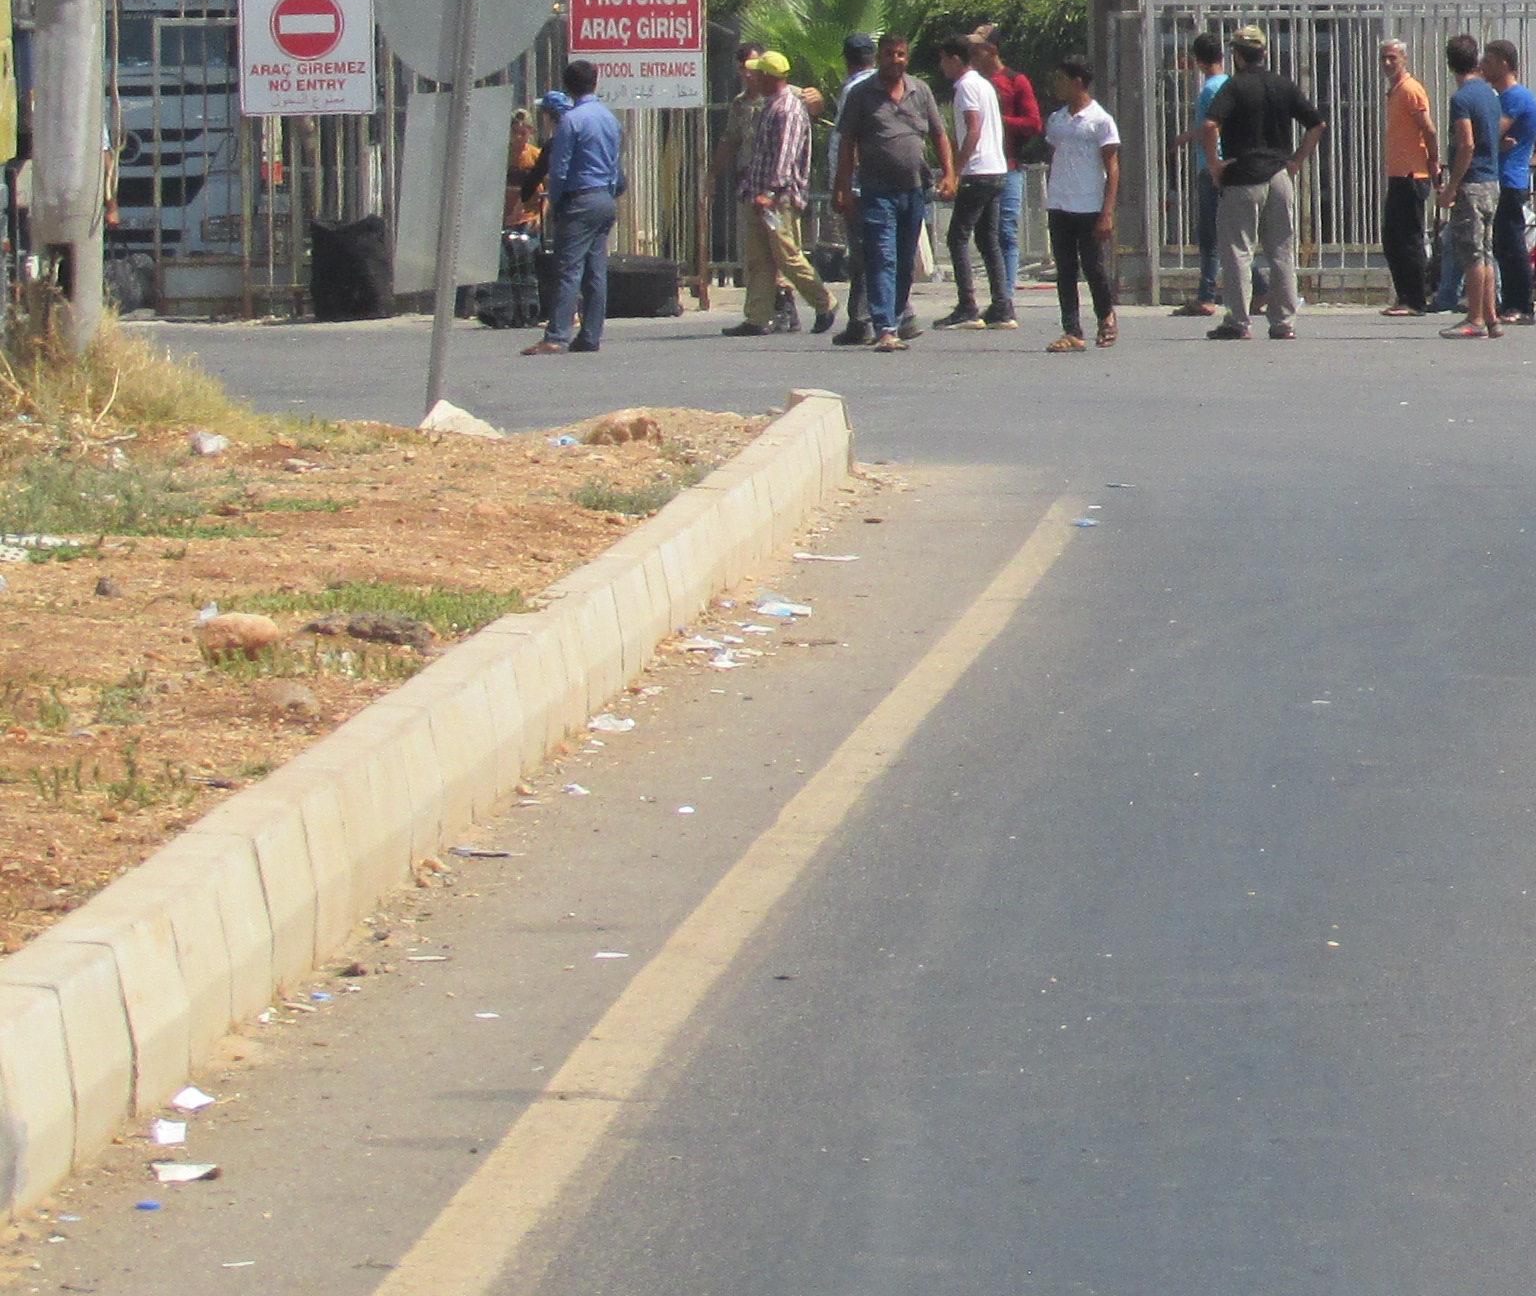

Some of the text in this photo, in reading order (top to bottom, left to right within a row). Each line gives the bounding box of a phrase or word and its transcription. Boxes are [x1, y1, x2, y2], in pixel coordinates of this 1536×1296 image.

[580, 10, 693, 45] ARAÇ GİRİŞİ
[250, 63, 292, 77] ARAÇ
[640, 61, 696, 78] ENTRANCE
[268, 77, 347, 92] NO ENTRY
